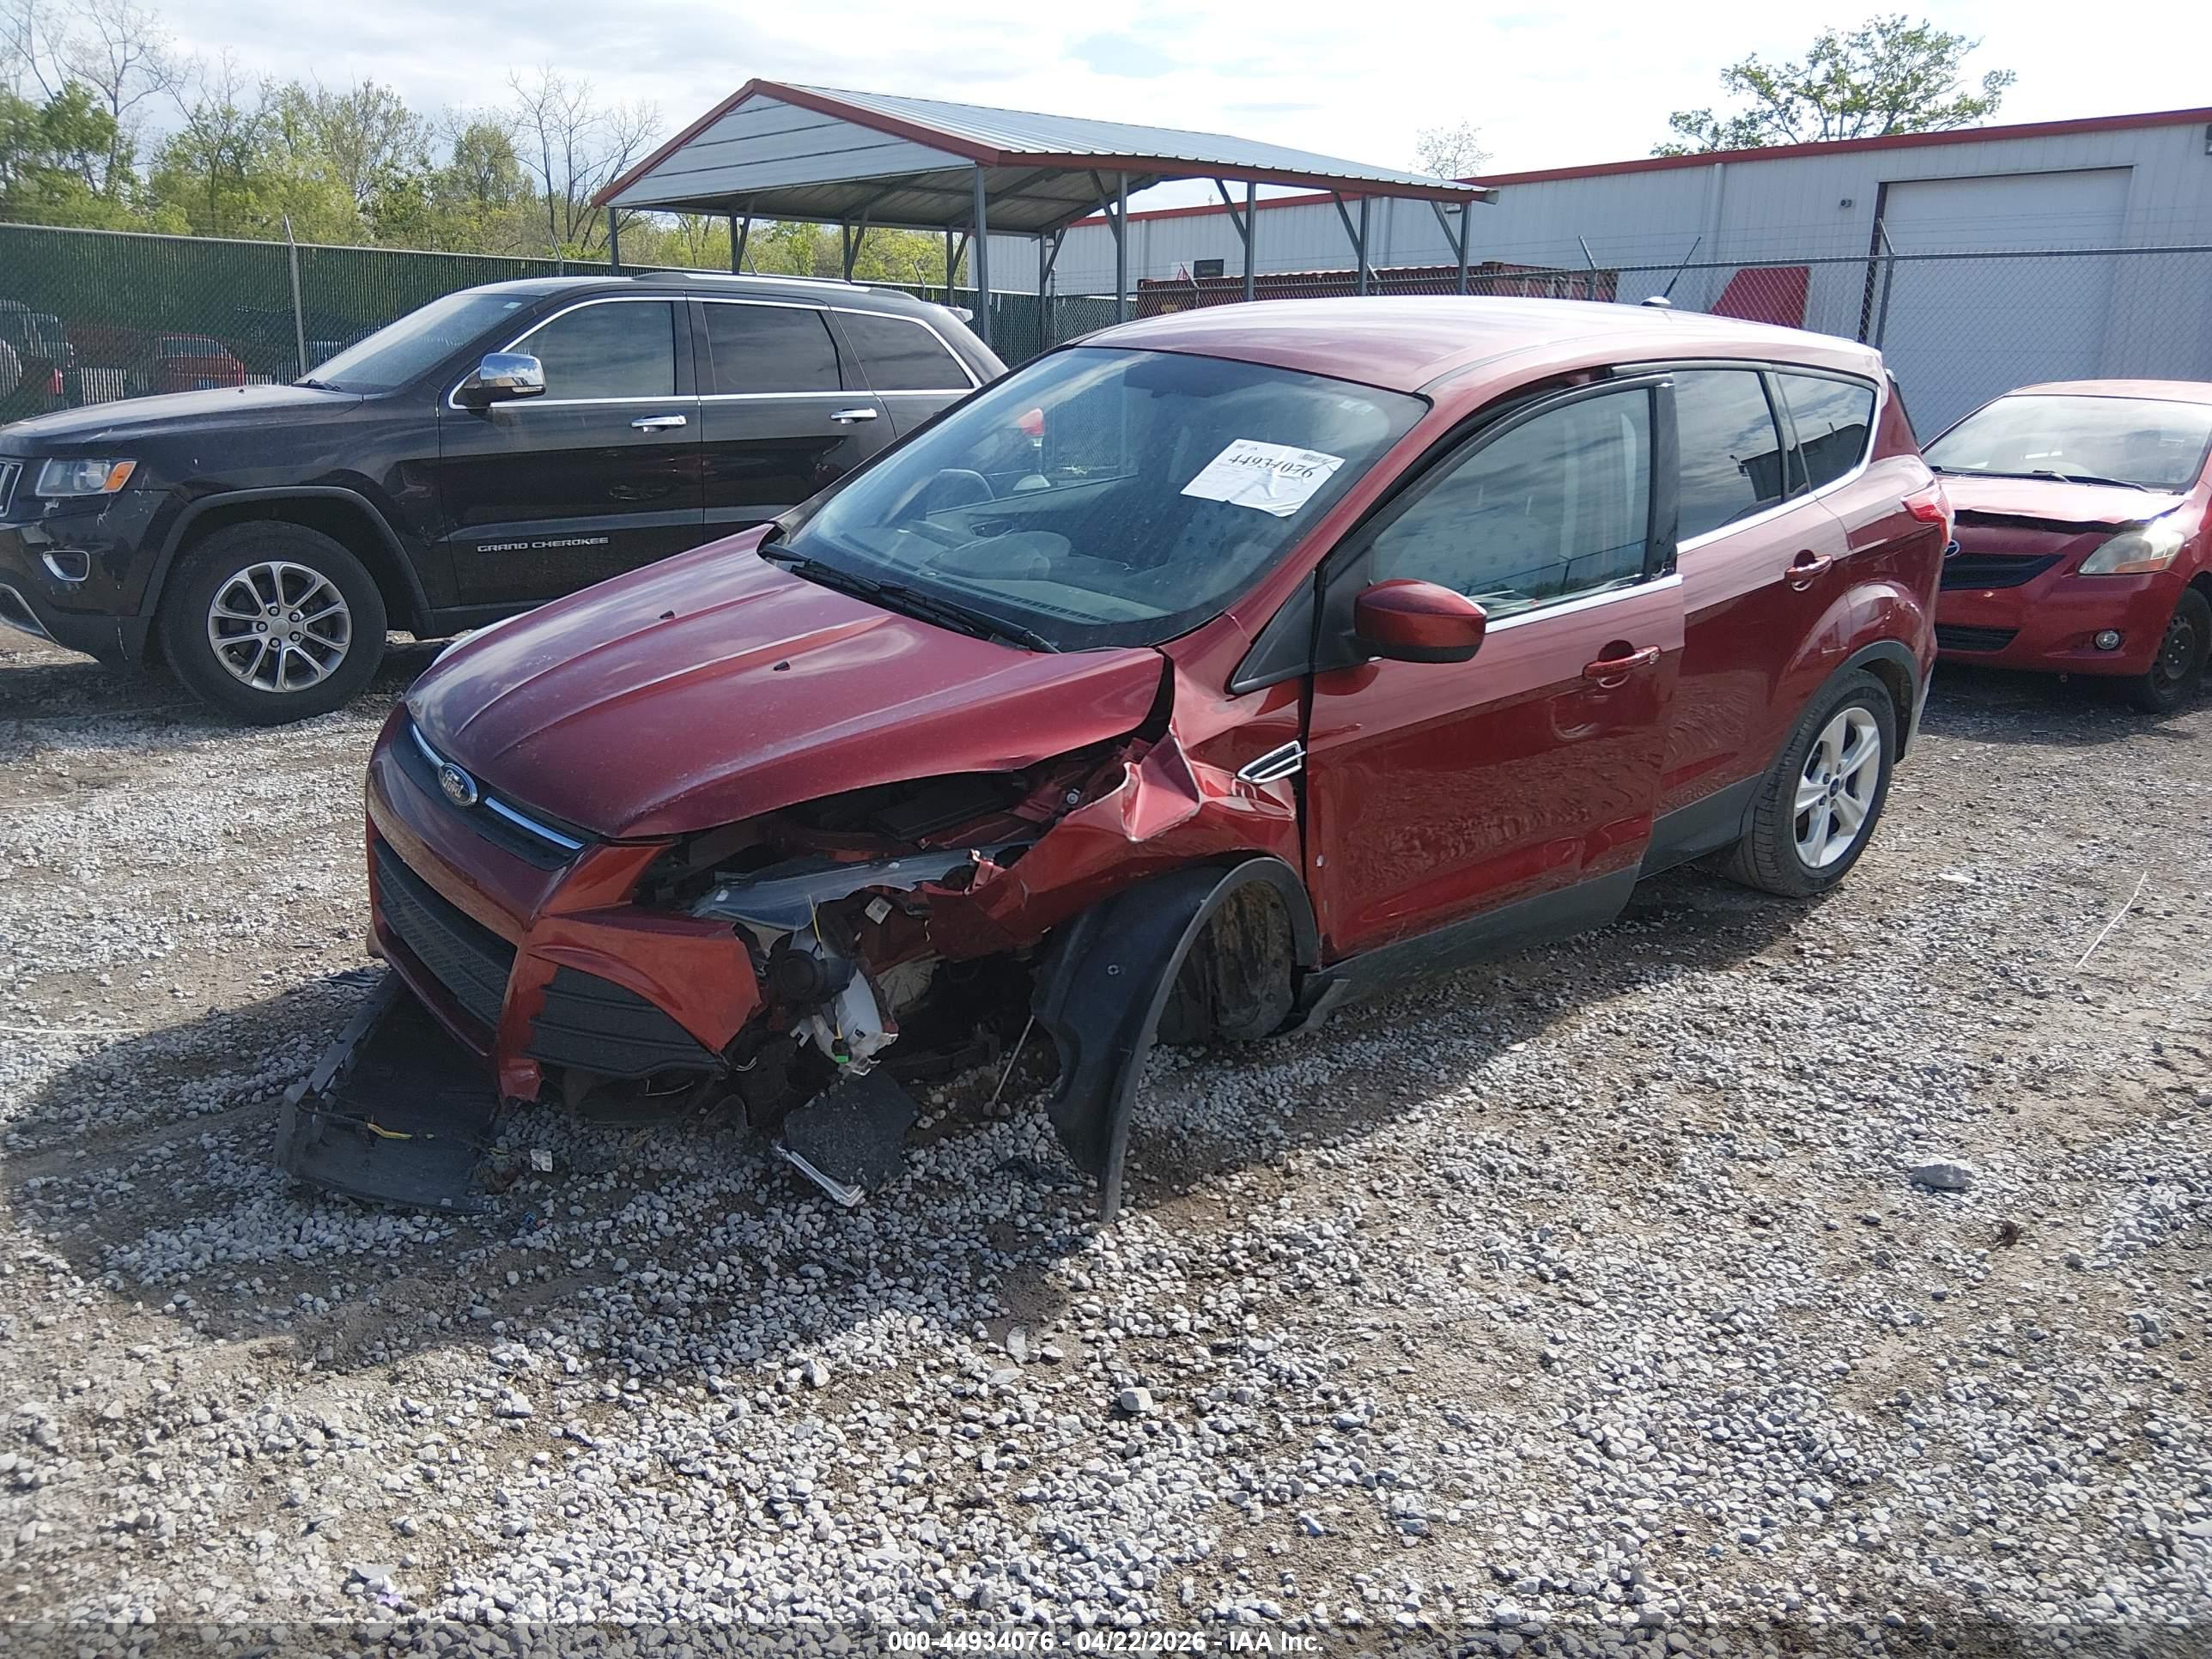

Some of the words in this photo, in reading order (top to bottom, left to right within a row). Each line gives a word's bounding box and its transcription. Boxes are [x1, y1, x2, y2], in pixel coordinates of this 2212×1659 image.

[1229, 453, 1315, 478] 44934076
[477, 542, 528, 552] GRAND
[532, 537, 609, 549] CHEROKEE
[441, 769, 465, 799] Ford
